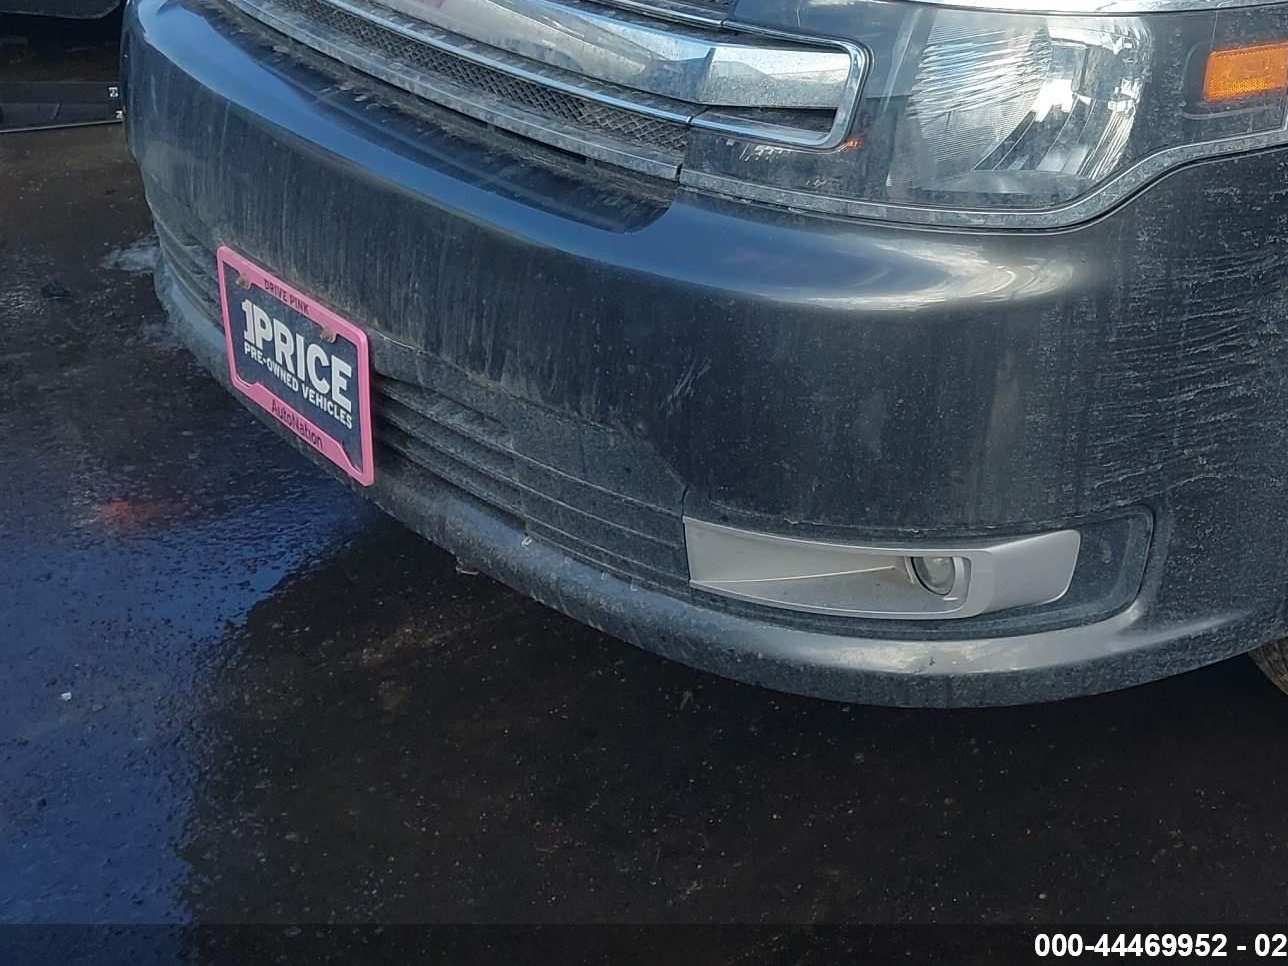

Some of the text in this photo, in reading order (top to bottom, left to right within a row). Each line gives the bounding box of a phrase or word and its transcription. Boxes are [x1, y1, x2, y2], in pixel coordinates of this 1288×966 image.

[264, 278, 309, 315] DRIVE PINK
[243, 341, 352, 429] PRE-OWNED VEHICLES
[271, 399, 323, 451] AutoNation
